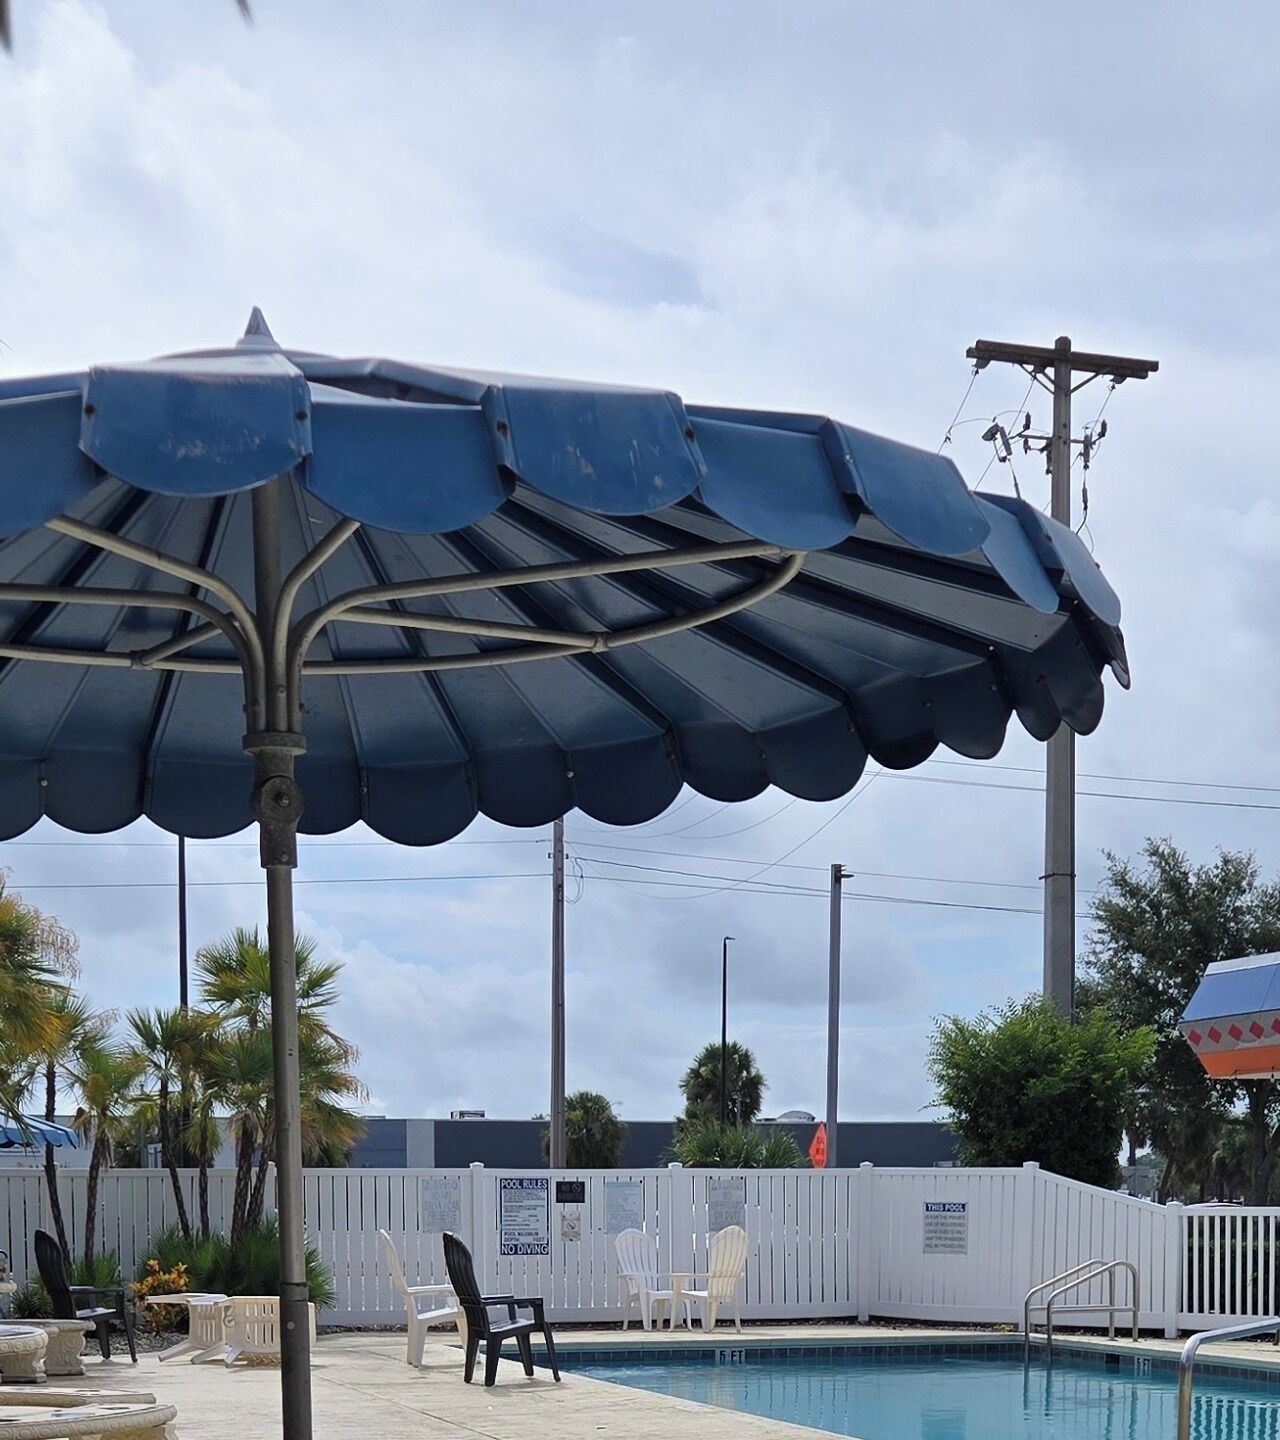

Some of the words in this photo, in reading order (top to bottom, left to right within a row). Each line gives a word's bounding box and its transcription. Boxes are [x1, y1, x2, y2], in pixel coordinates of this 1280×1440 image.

[501, 1179, 522, 1189] POOL
[523, 1179, 548, 1189] RULES
[927, 1203, 943, 1211] THIS
[945, 1203, 964, 1211] POOL
[501, 1244, 515, 1255] NO
[517, 1244, 549, 1255] DIVING
[730, 1350, 744, 1364] FT
